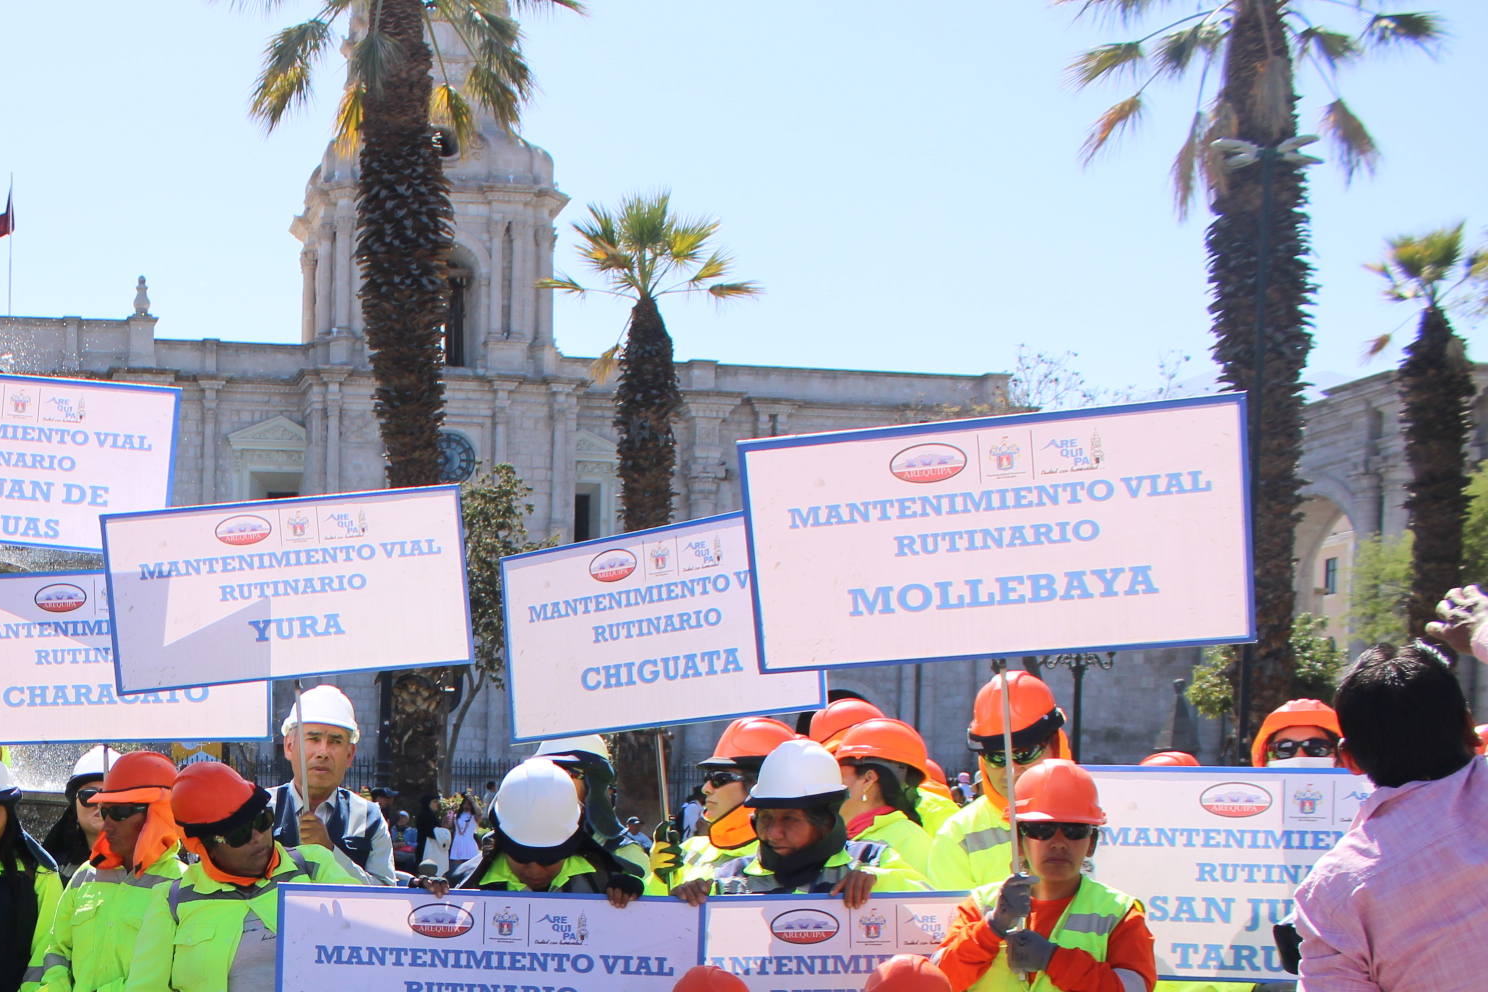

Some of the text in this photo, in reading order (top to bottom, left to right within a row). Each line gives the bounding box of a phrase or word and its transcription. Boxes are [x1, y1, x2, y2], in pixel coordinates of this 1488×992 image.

[93, 431, 152, 451] VIAL
[902, 466, 953, 479] AREQUIPA
[904, 454, 955, 468] IVP
[61, 482, 109, 506] DE
[787, 470, 1212, 529] MANTENIMIENTO VIAL
[224, 532, 261, 542] AREQUIPA
[893, 518, 1100, 556] RUTINARIO
[138, 538, 441, 580] MANTENIMIENTO VIAL
[597, 567, 628, 579] AREQUIPA
[218, 572, 367, 601] RUTINARIO
[527, 573, 730, 623] MANTENIMIENTO
[848, 564, 1159, 616] MOLLEBAYA
[248, 612, 345, 641] YURA
[591, 607, 722, 643] RUTINARIO
[34, 647, 113, 665] RUTIN
[581, 647, 742, 690] CHIGUATA
[1210, 804, 1258, 812] AREQUIPA
[421, 915, 463, 924] IVP
[1148, 895, 1235, 924] SAN
[417, 925, 461, 933] AREQUIPA
[781, 931, 826, 939] AREQUIPA
[784, 920, 828, 929] IVP
[314, 944, 674, 976] MANTENIMIENTO VIAL
